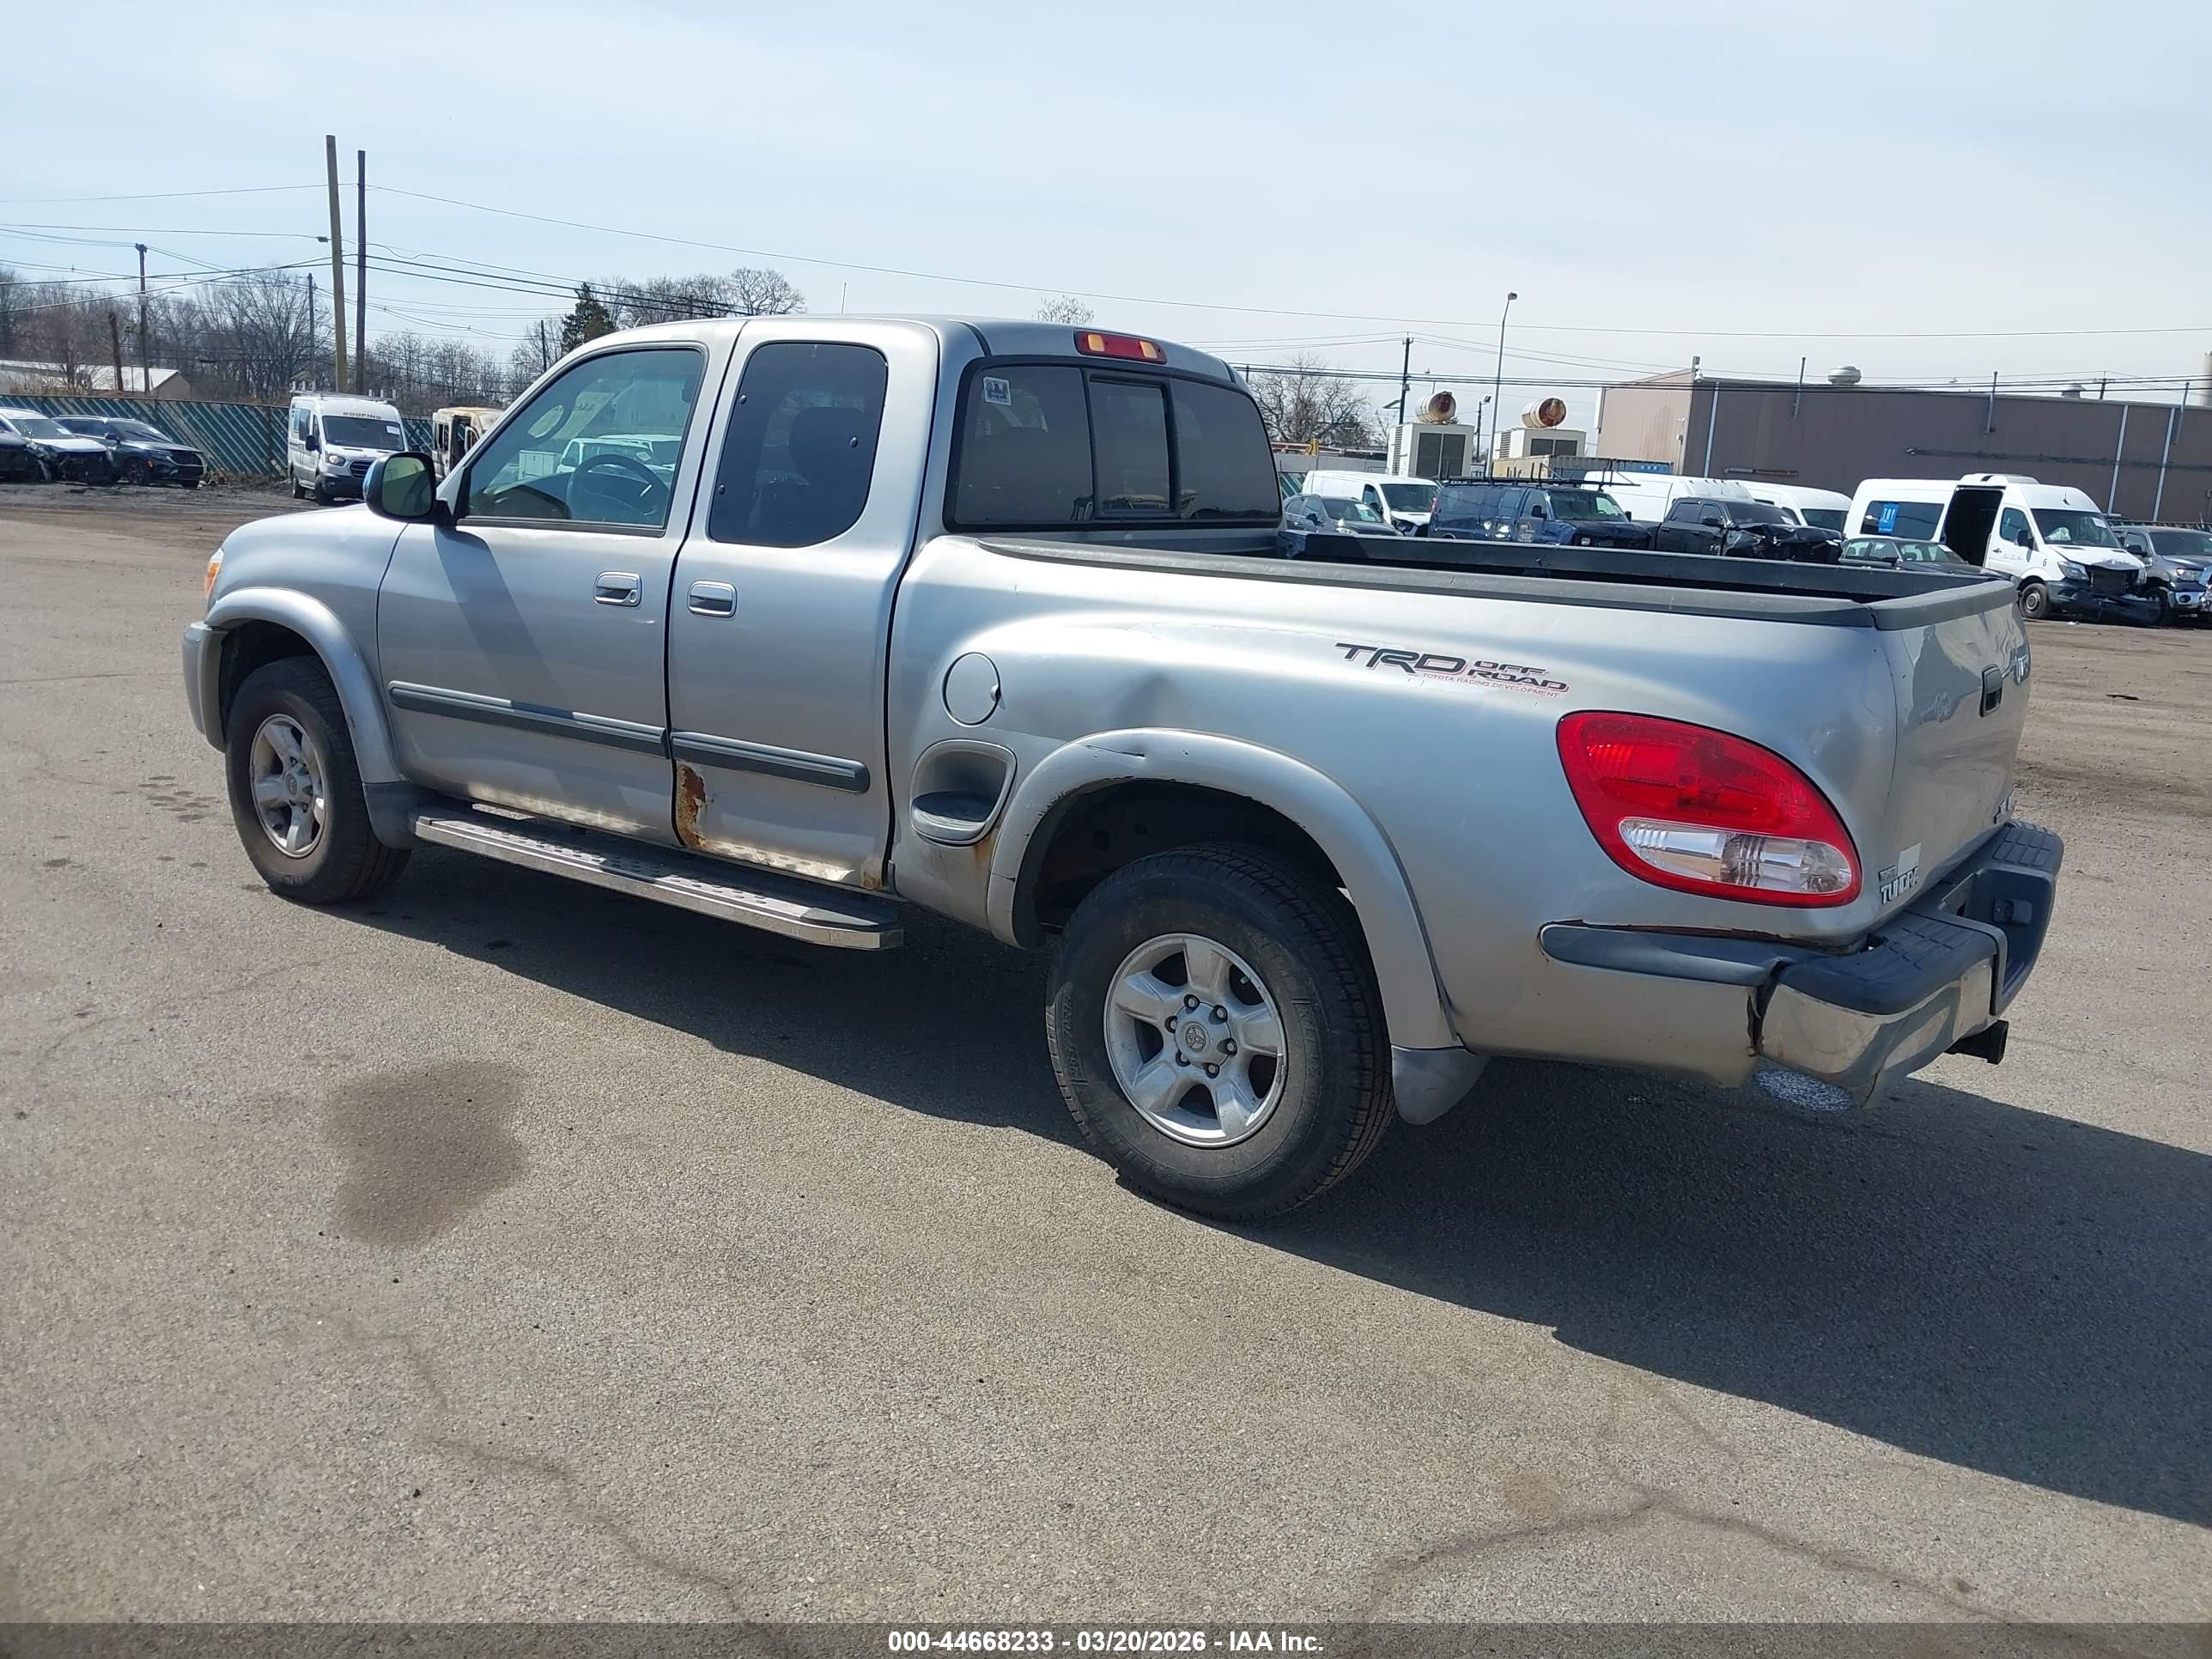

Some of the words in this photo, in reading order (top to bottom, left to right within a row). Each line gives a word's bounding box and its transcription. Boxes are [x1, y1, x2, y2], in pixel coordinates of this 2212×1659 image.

[1334, 641, 1467, 675] TRD
[1473, 659, 1547, 675] OFF
[1422, 673, 1454, 682] TOYOTA
[1456, 677, 1491, 687] RACING
[1492, 682, 1560, 699] DEVELOPMENT
[1467, 669, 1569, 692] ROAD
